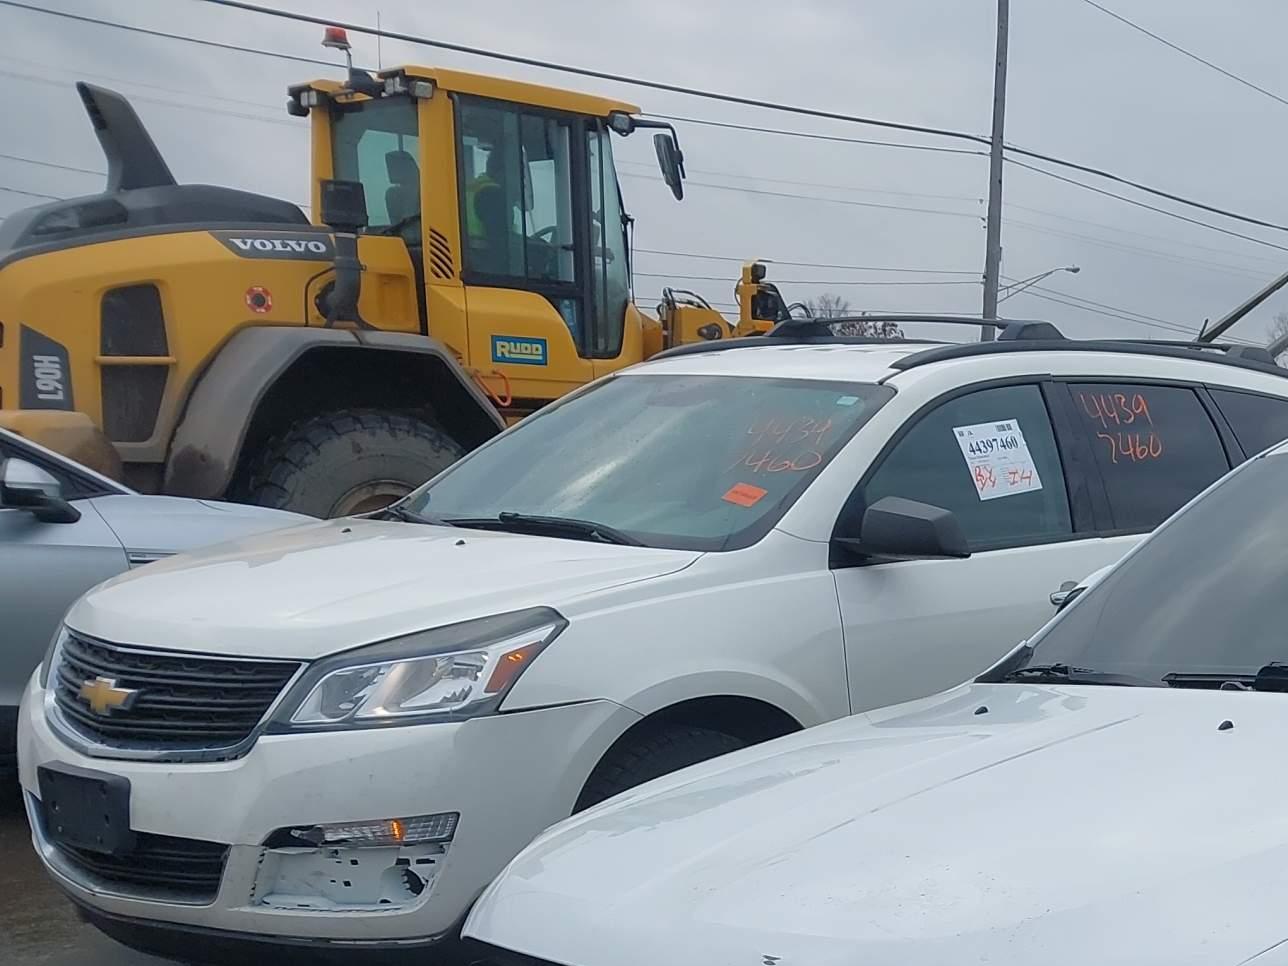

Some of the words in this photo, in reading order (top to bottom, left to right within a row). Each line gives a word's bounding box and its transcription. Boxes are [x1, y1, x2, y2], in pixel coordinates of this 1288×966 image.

[229, 239, 326, 253] VOLVO
[32, 355, 64, 400] L90H
[1080, 393, 1153, 429] 4439
[968, 436, 1019, 455] 44397460
[1096, 432, 1162, 464] 7460
